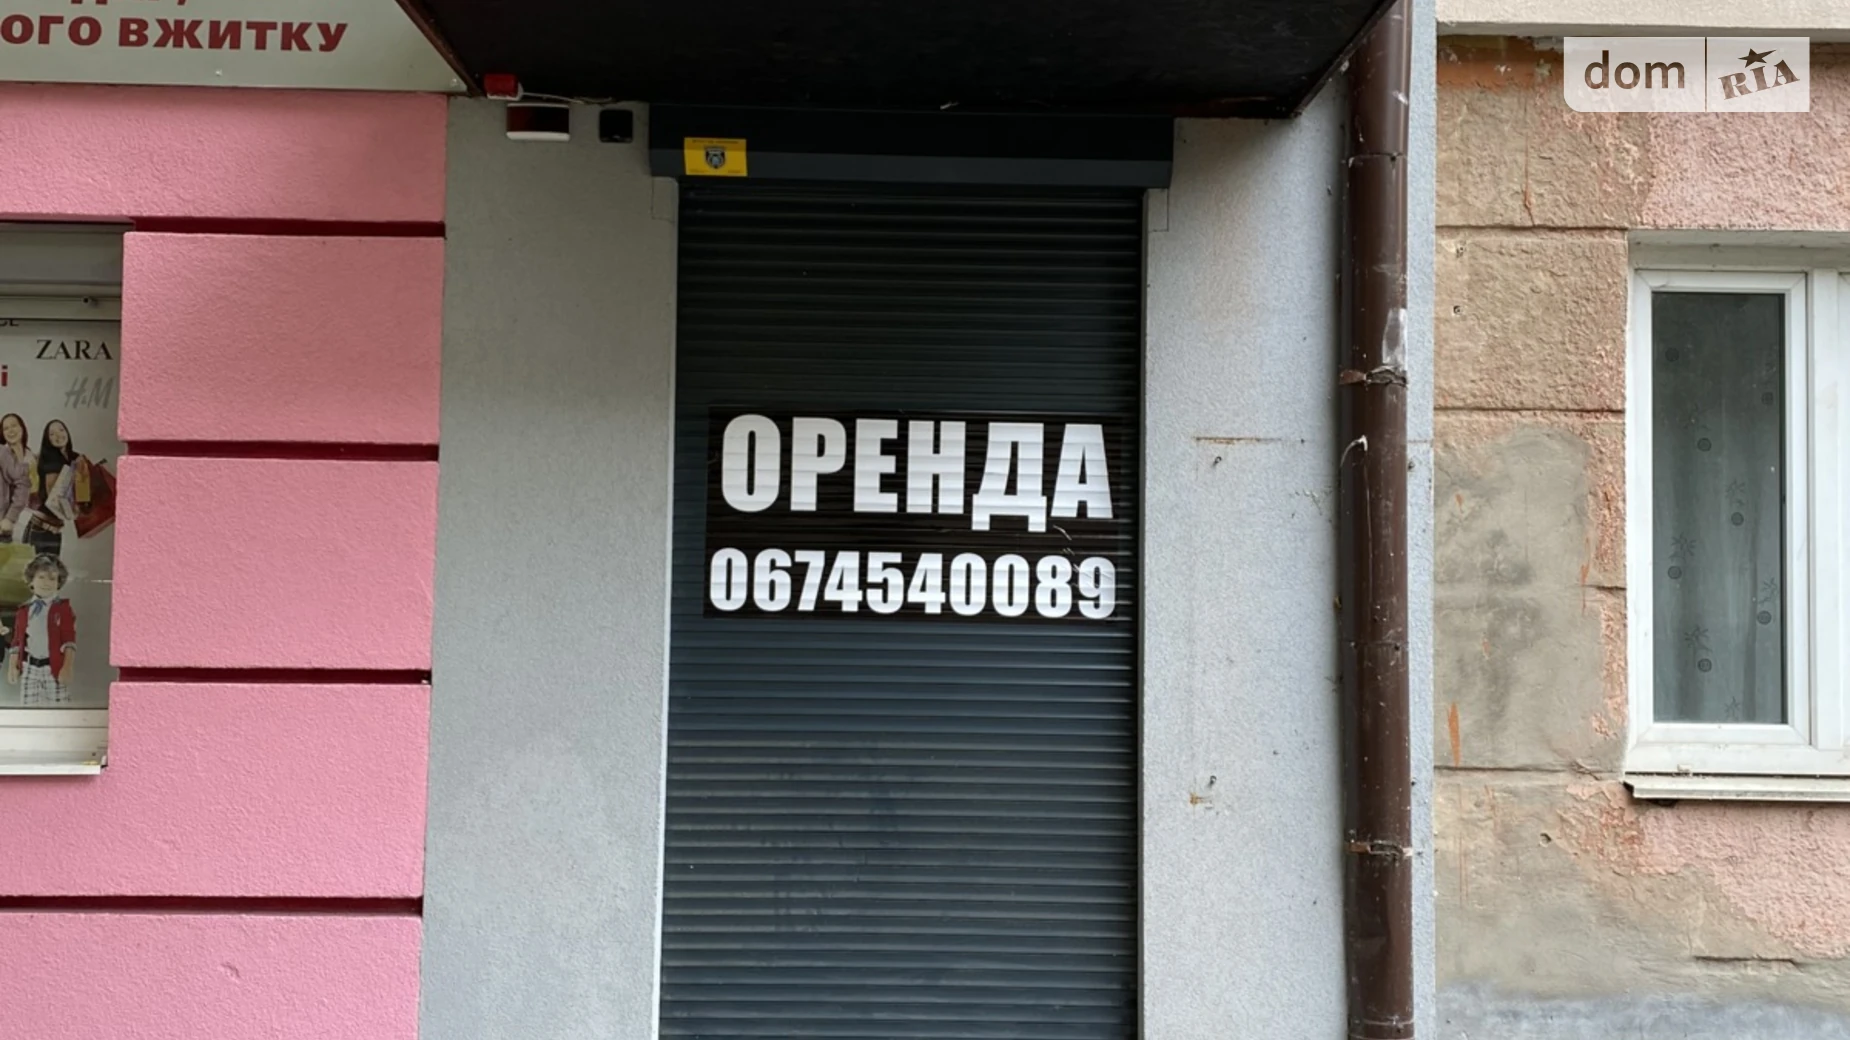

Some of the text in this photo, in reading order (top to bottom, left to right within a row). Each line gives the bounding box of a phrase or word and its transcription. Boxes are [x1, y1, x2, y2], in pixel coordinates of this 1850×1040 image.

[118, 17, 349, 52] ВЖИТКУ
[36, 339, 114, 360] ZARA
[722, 413, 1113, 532] ОРЕНДА
[709, 547, 1117, 620] 0674540089
